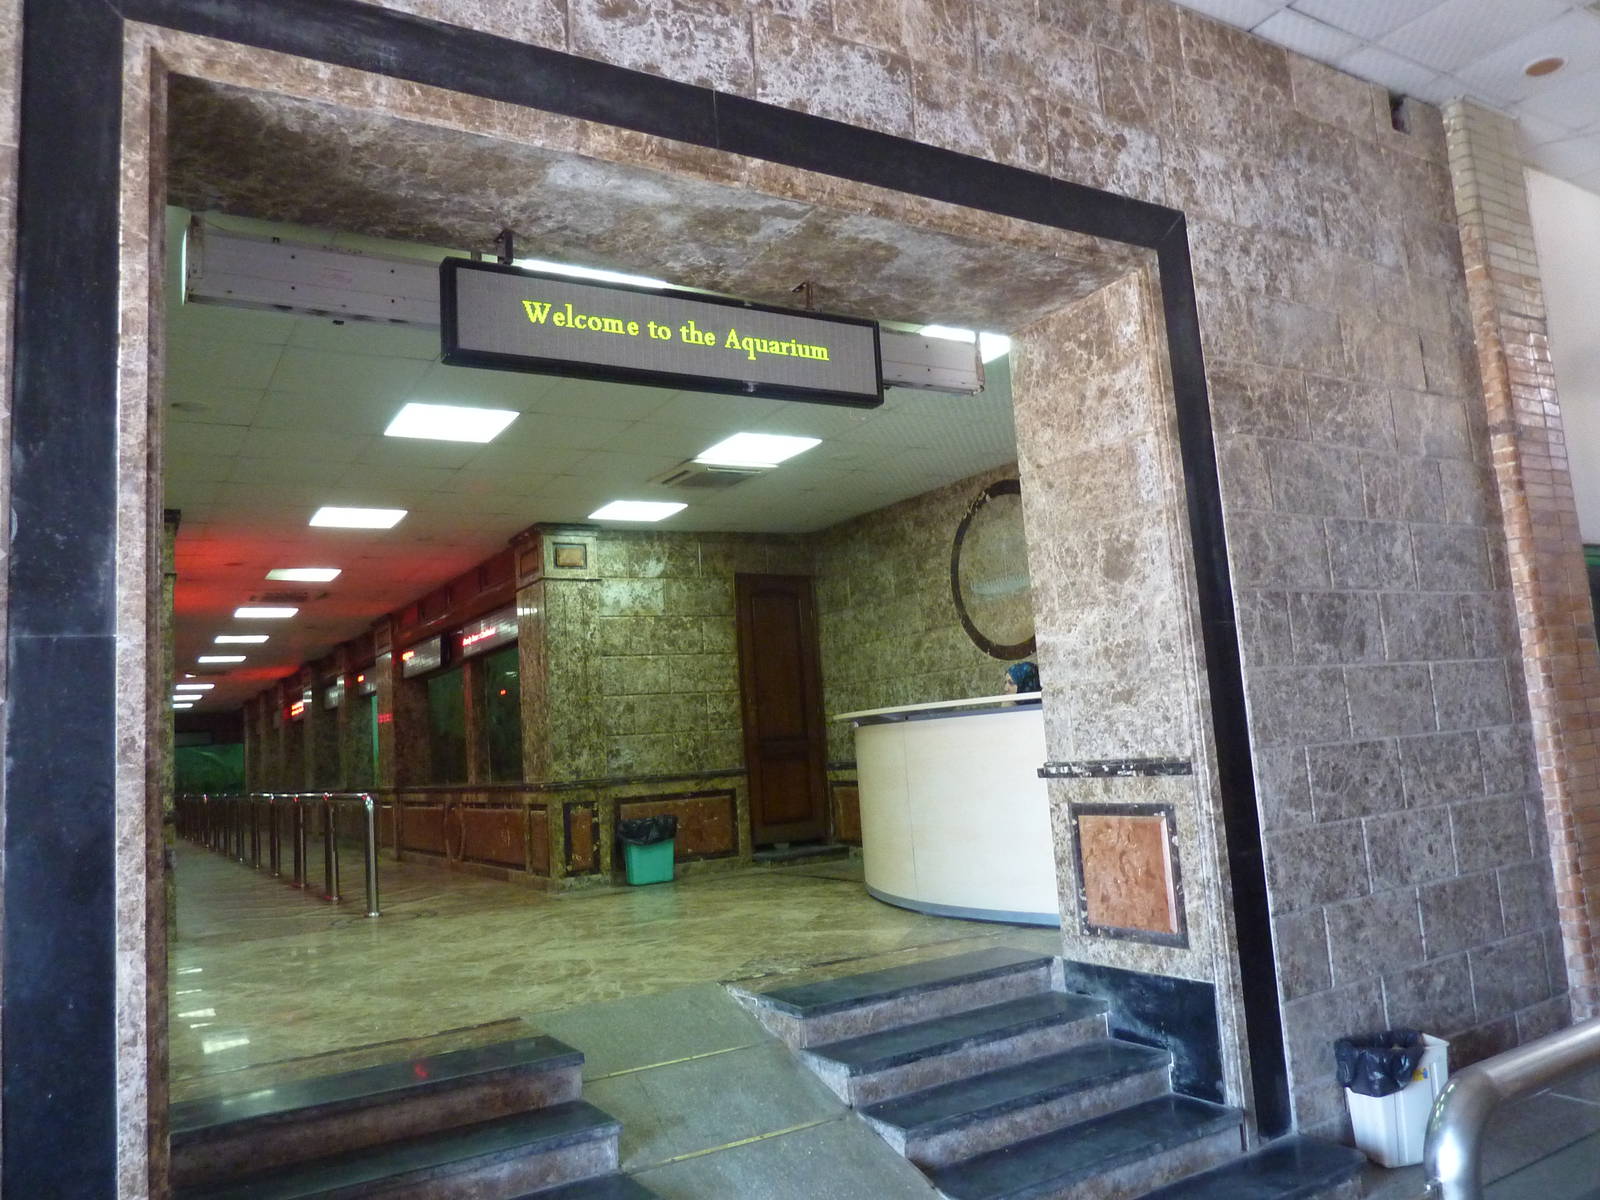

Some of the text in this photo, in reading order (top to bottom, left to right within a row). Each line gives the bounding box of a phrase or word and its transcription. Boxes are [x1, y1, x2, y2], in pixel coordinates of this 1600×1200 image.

[522, 300, 831, 361] Welcome to the Aquarium
